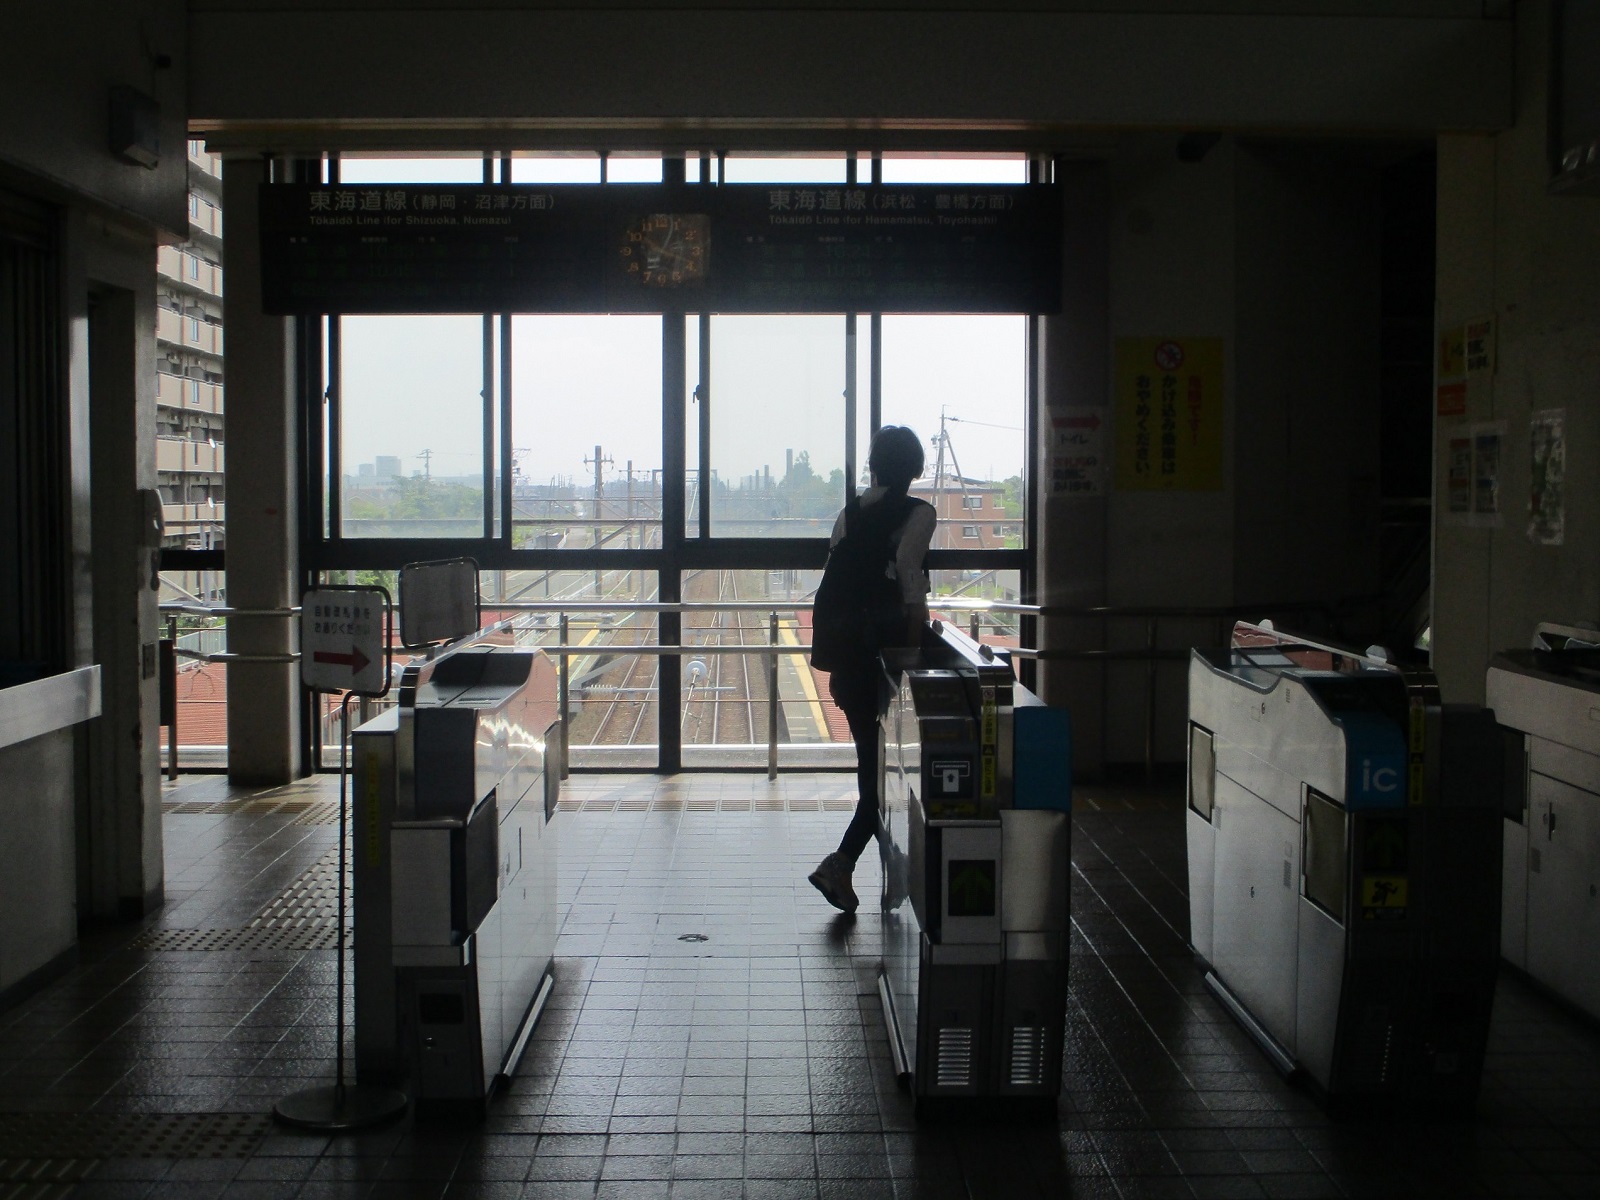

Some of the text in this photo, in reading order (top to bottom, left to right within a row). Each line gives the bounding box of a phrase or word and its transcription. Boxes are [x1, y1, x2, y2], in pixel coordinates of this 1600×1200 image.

[356, 215, 380, 225] Line
[406, 215, 460, 226] Shizuoka,
[816, 215, 840, 225] Line
[1362, 759, 1398, 792] ic
